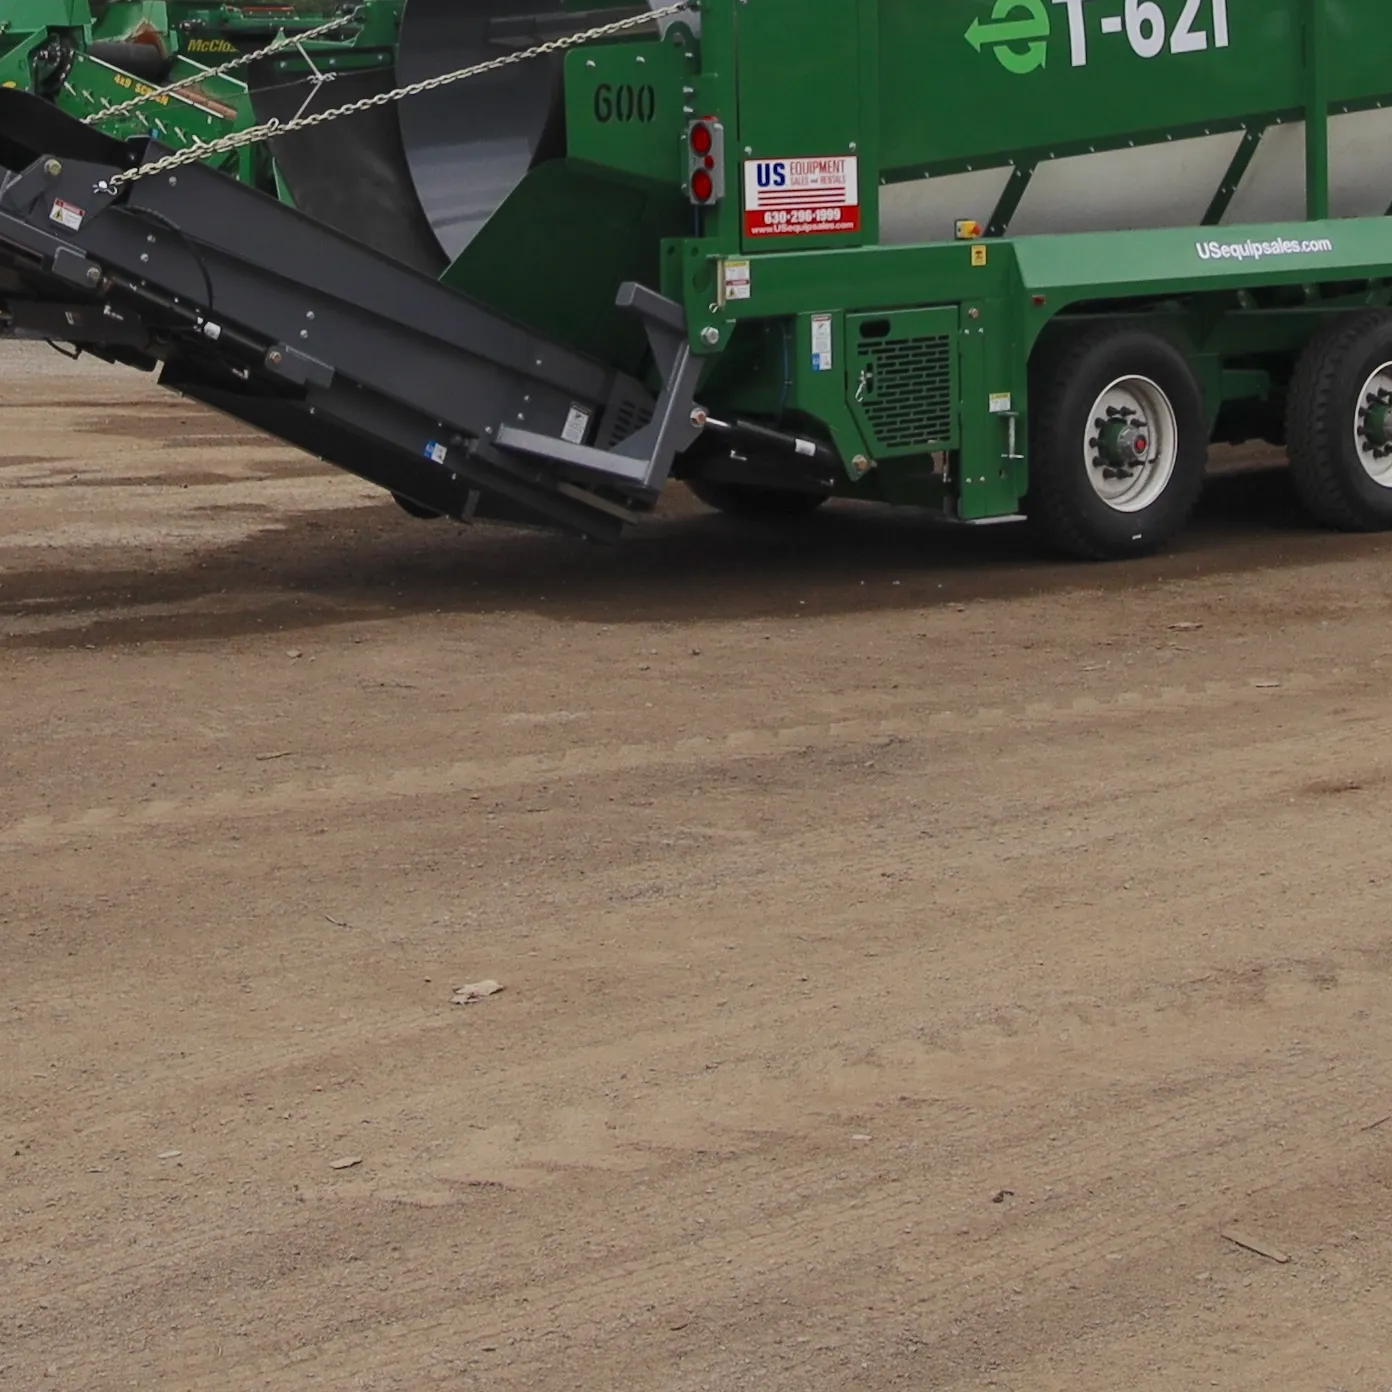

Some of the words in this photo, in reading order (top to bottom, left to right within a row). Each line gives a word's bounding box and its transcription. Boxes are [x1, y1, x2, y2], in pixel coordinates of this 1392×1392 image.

[593, 83, 656, 123] 600
[756, 162, 786, 187] US
[789, 160, 846, 175] EQUIPMENT
[790, 177, 809, 186] SALES
[751, 221, 854, 234] www.USequipsales.com
[1196, 236, 1333, 260] USequipsales.com
